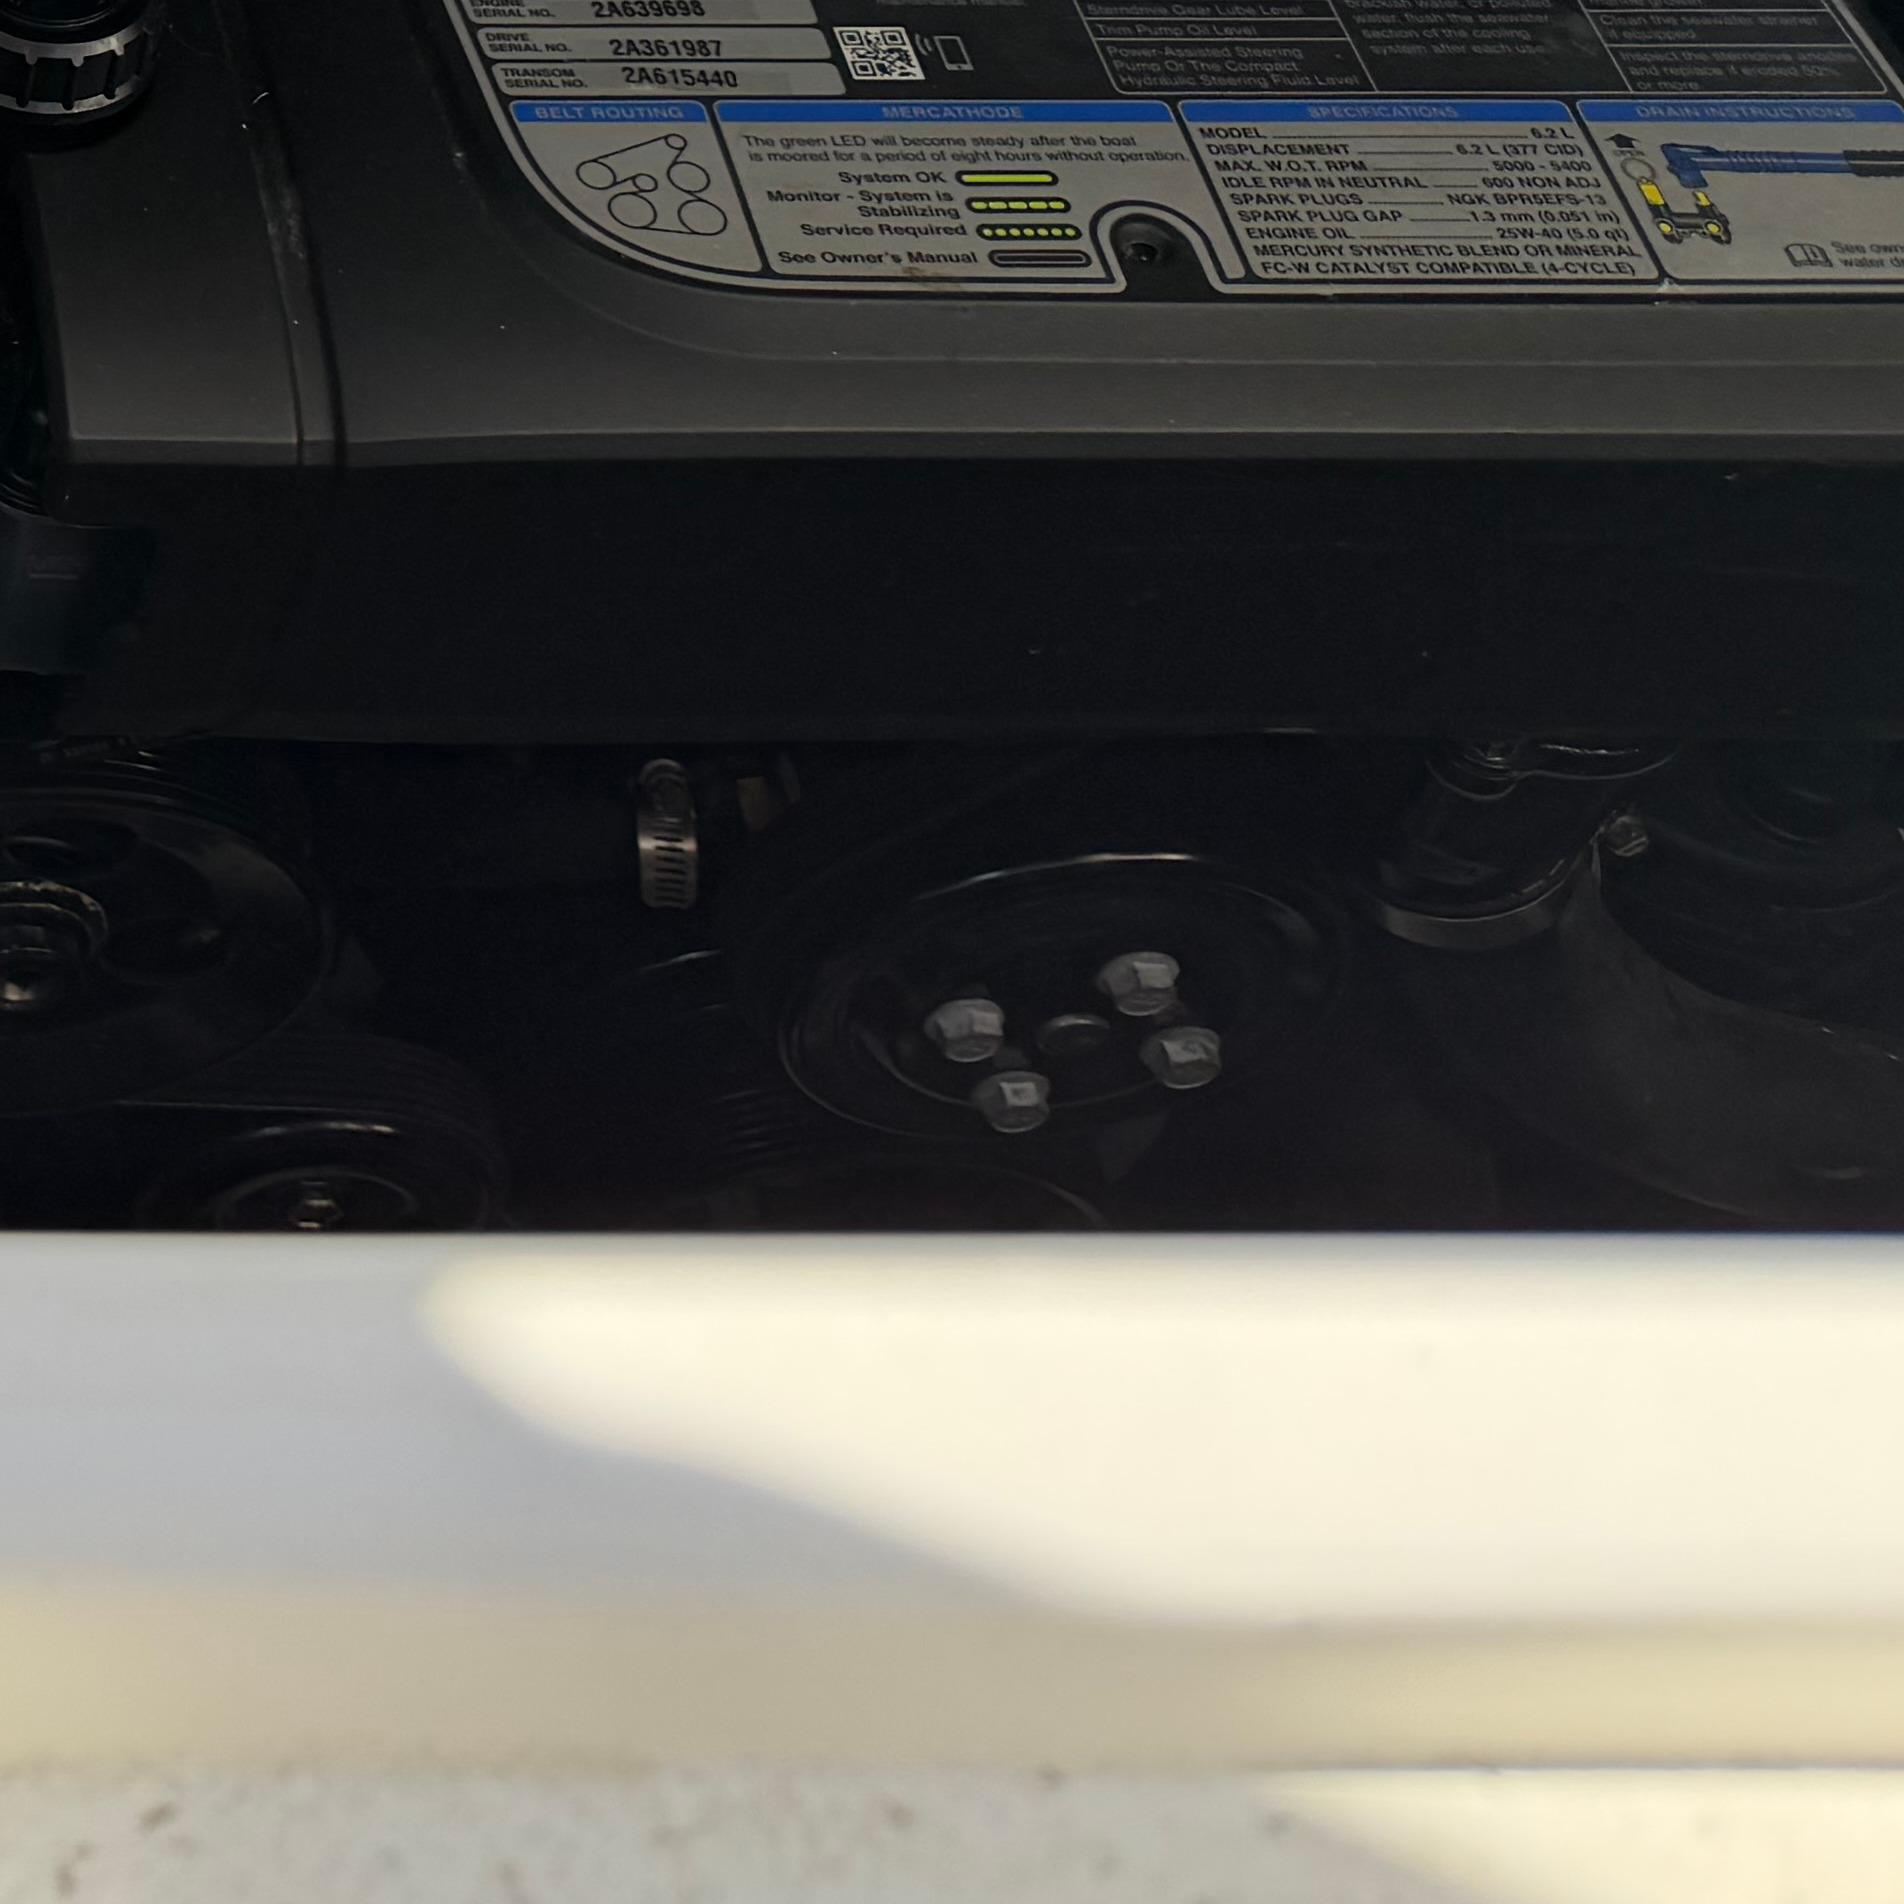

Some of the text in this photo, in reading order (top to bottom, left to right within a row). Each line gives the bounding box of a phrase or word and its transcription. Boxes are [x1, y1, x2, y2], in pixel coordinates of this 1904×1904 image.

[474, 9, 555, 18] SERIAL NO.
[591, 0, 705, 18] 2A639698
[486, 33, 529, 42] DRIVE
[490, 43, 571, 52] SERIAL NO.
[610, 39, 721, 56] 2A361987
[502, 68, 576, 77] TRANSOM
[622, 67, 737, 87] 2A615440
[505, 79, 587, 88] SERIAL NO.
[535, 107, 684, 119] BELT ROUTING
[882, 107, 1023, 119] MERCATHODE
[1308, 106, 1458, 119] SPECIFICATIONS
[1637, 106, 1855, 118] DRAIN INSTRUCTIONS
[1200, 128, 1574, 139] MODEL 6.2 L
[1207, 143, 1583, 157] DISPLACEMENT 6.2 L (377 CID)
[1215, 160, 1592, 171] MAX. W.O.T. RPM 5000 5400
[839, 172, 946, 184] System OK
[1223, 178, 1601, 188] IDLE RPM IN NEUTRAL 600 NON ADJ
[768, 190, 953, 203] Monitor System is
[1231, 194, 1294, 205] SPARK
[1300, 194, 1363, 205] PLUGS
[1448, 195, 1489, 205] NGK
[858, 206, 959, 219] Stabilizing
[1238, 211, 1301, 222] SPARK
[1307, 211, 1359, 222] PLUG
[1364, 211, 1402, 222] GAP
[1470, 212, 1495, 222] 1.3
[1500, 213, 1534, 222] mm
[1596, 211, 1620, 224] in)
[801, 224, 966, 238] Service Required
[1247, 228, 1629, 241] ENGINE OIL 25W-40 (5.0 qt)
[1253, 245, 1641, 256] MERCURY SYNTHETIC BLEND OR MINERAL
[779, 252, 977, 264] See Owner's Manual
[1262, 262, 1634, 275] FC-W CATALYST COMPATIBLE (4-CYCLE)
